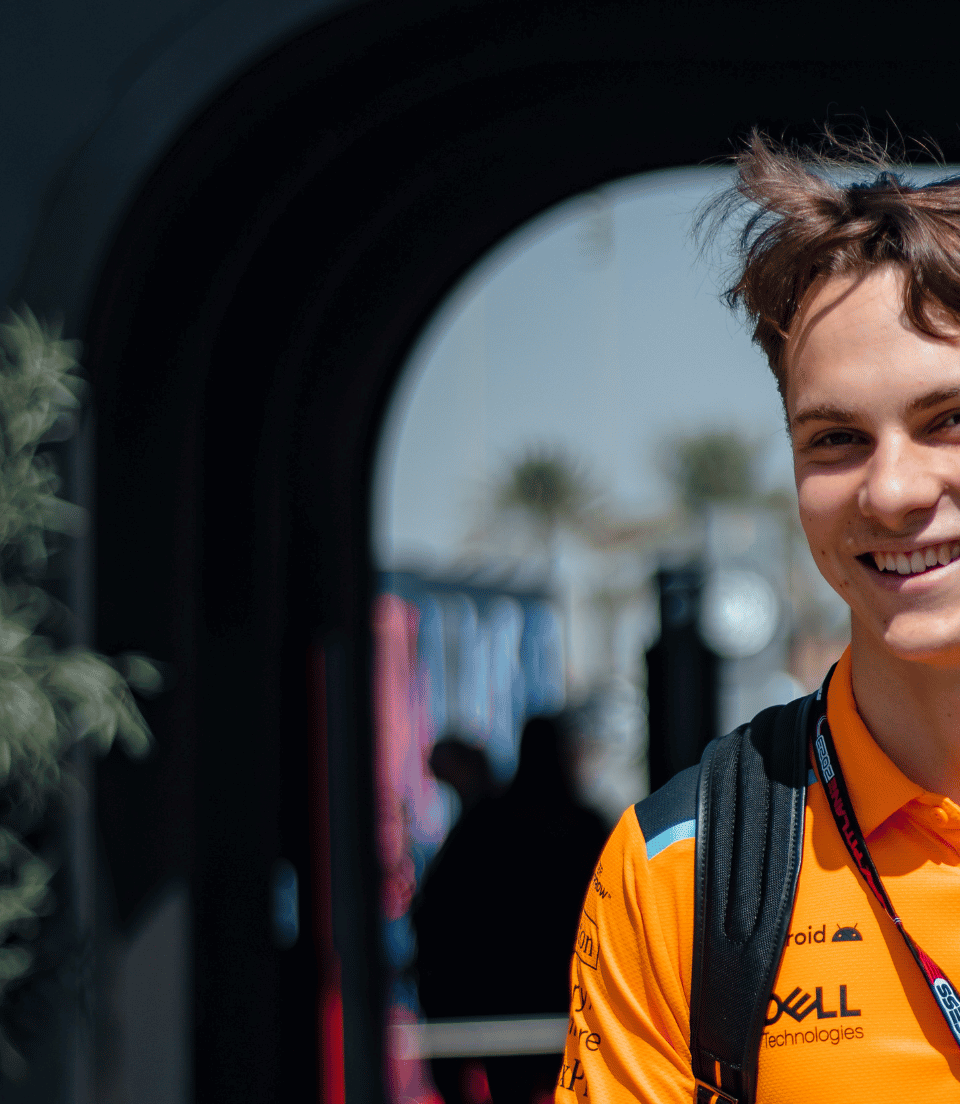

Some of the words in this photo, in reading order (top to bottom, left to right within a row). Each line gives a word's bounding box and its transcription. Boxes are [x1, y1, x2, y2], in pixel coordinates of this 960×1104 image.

[815, 735, 836, 784] 2023
[786, 924, 826, 946] roid
[762, 1025, 864, 1049] Technologies
